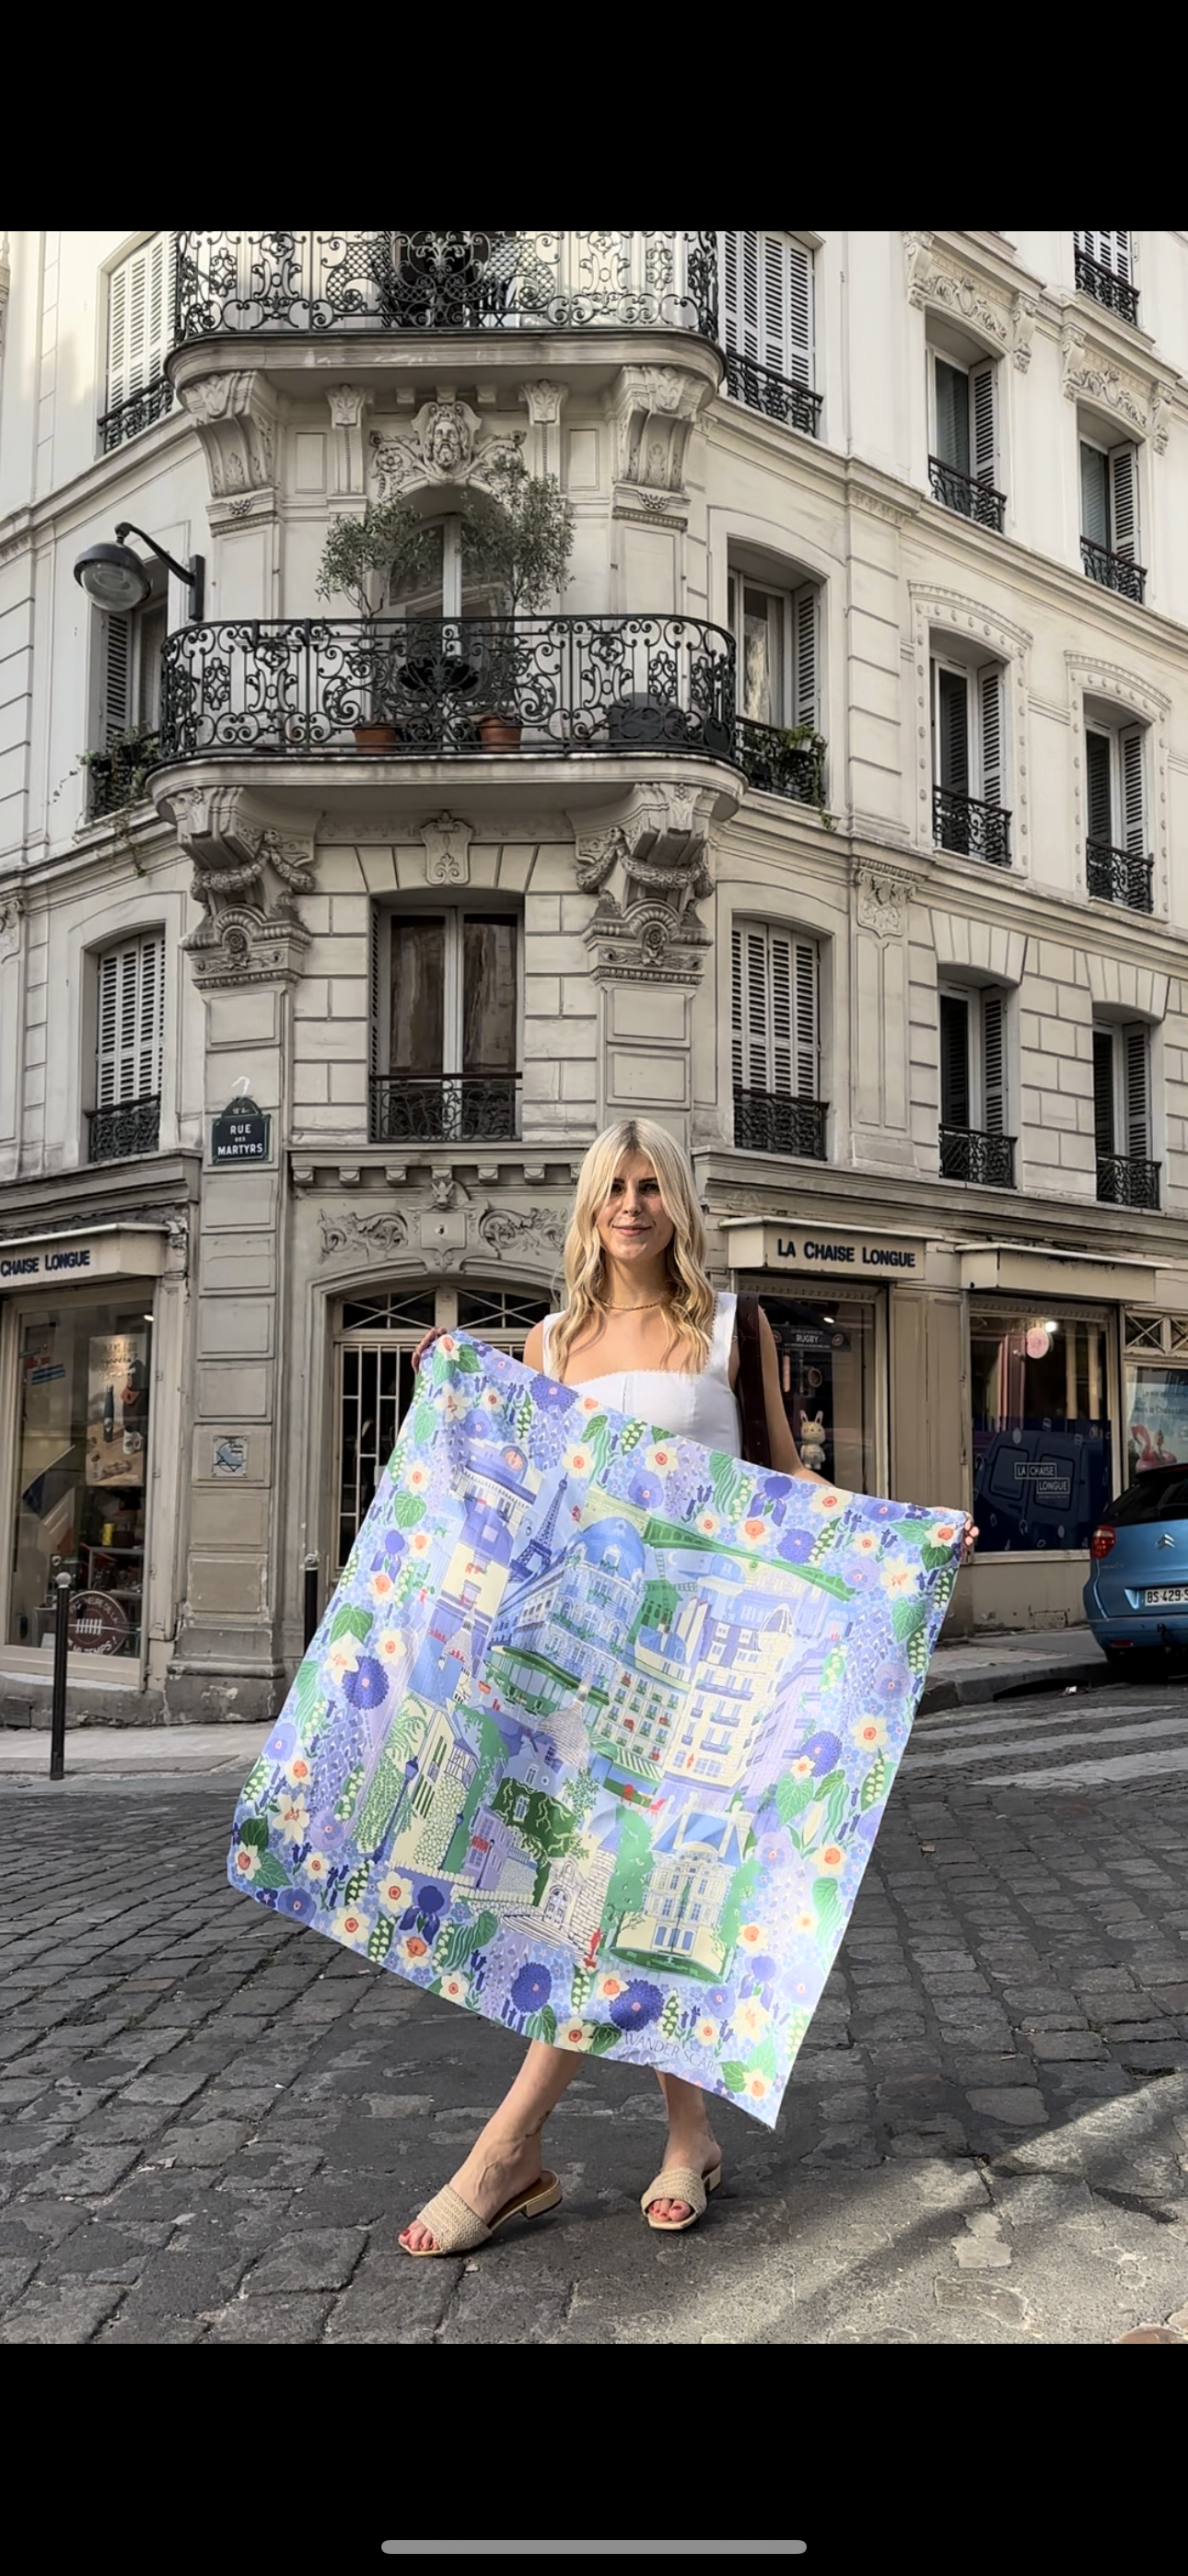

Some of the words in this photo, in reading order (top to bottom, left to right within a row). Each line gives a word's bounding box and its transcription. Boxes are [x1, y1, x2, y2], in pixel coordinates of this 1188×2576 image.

[230, 1124, 251, 1135] RUE
[217, 1143, 263, 1156] MARTYRS
[777, 1238, 797, 1258] LA
[803, 1241, 856, 1262] CHAISE
[862, 1247, 916, 1268] LONGUE
[0, 1257, 40, 1278] CHAISE
[44, 1250, 90, 1271] LONGUE
[796, 1334, 819, 1343] RUGBY
[1017, 1466, 1026, 1476] LA
[1029, 1466, 1054, 1477] CHAISE
[1039, 1481, 1067, 1491] LONGUE
[625, 2032, 680, 2059] WANDER
